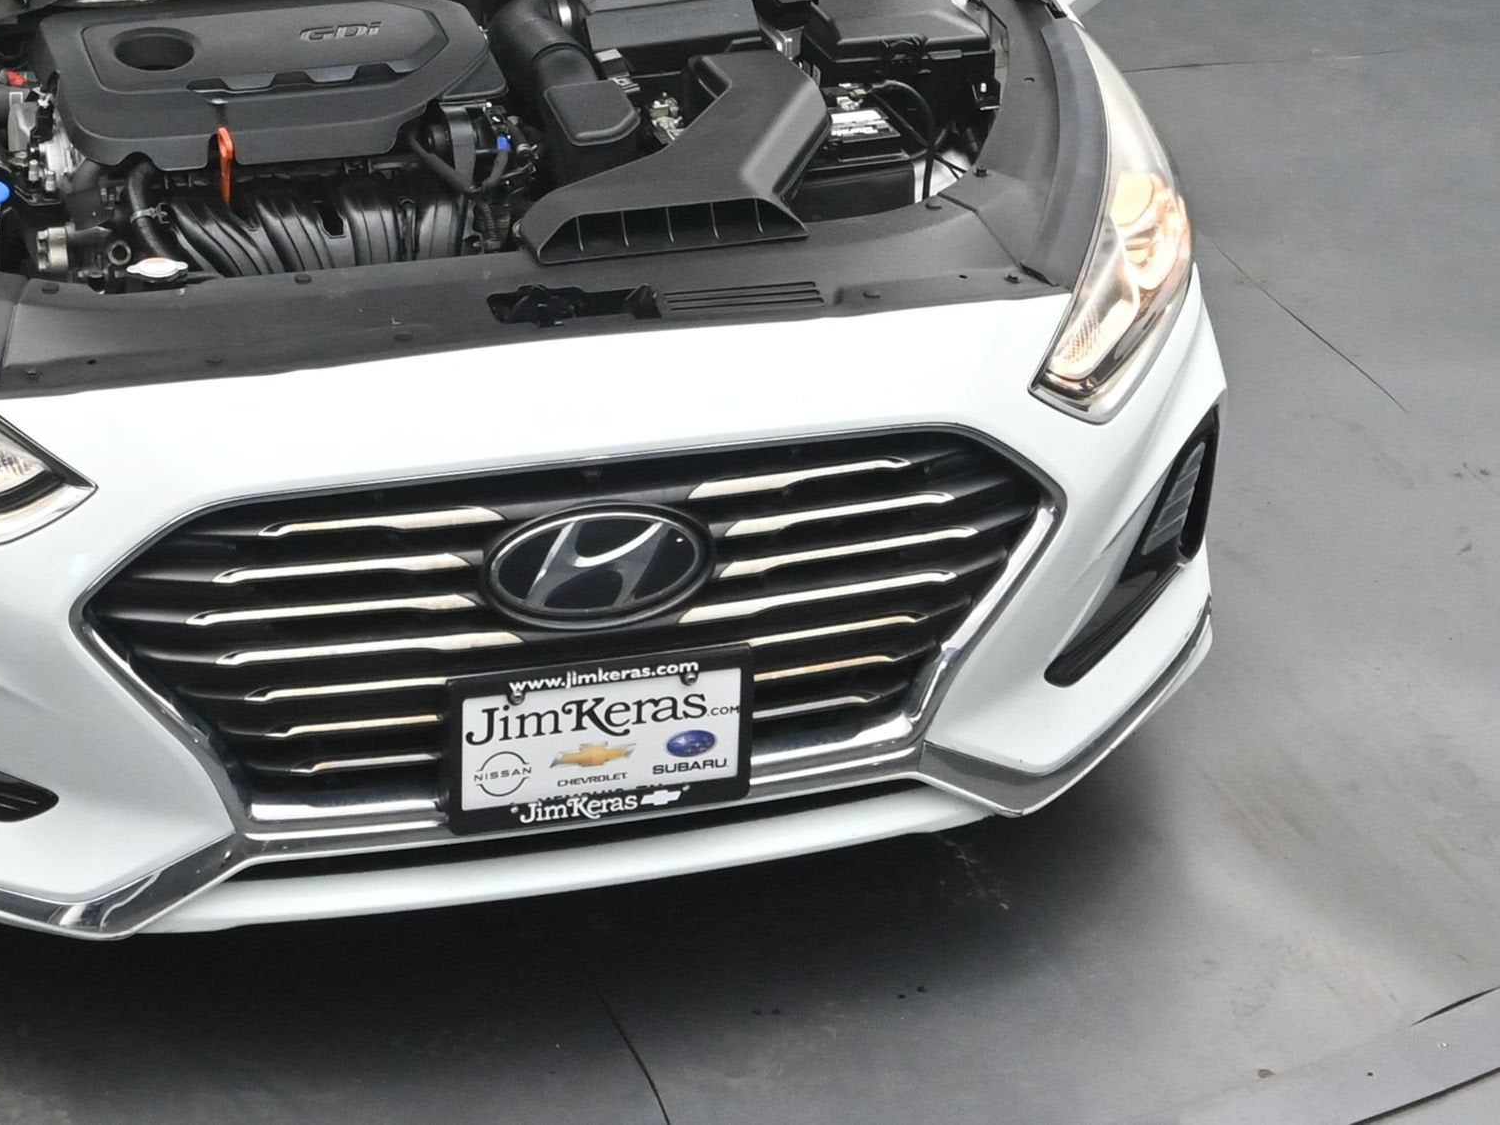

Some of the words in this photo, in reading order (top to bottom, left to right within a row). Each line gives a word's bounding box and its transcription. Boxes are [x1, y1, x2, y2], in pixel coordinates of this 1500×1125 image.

[509, 660, 699, 693] www.jimkeras.com
[473, 767, 533, 783] NISSAN
[652, 758, 728, 776] SUBARU
[556, 772, 628, 788] CHEVROLET
